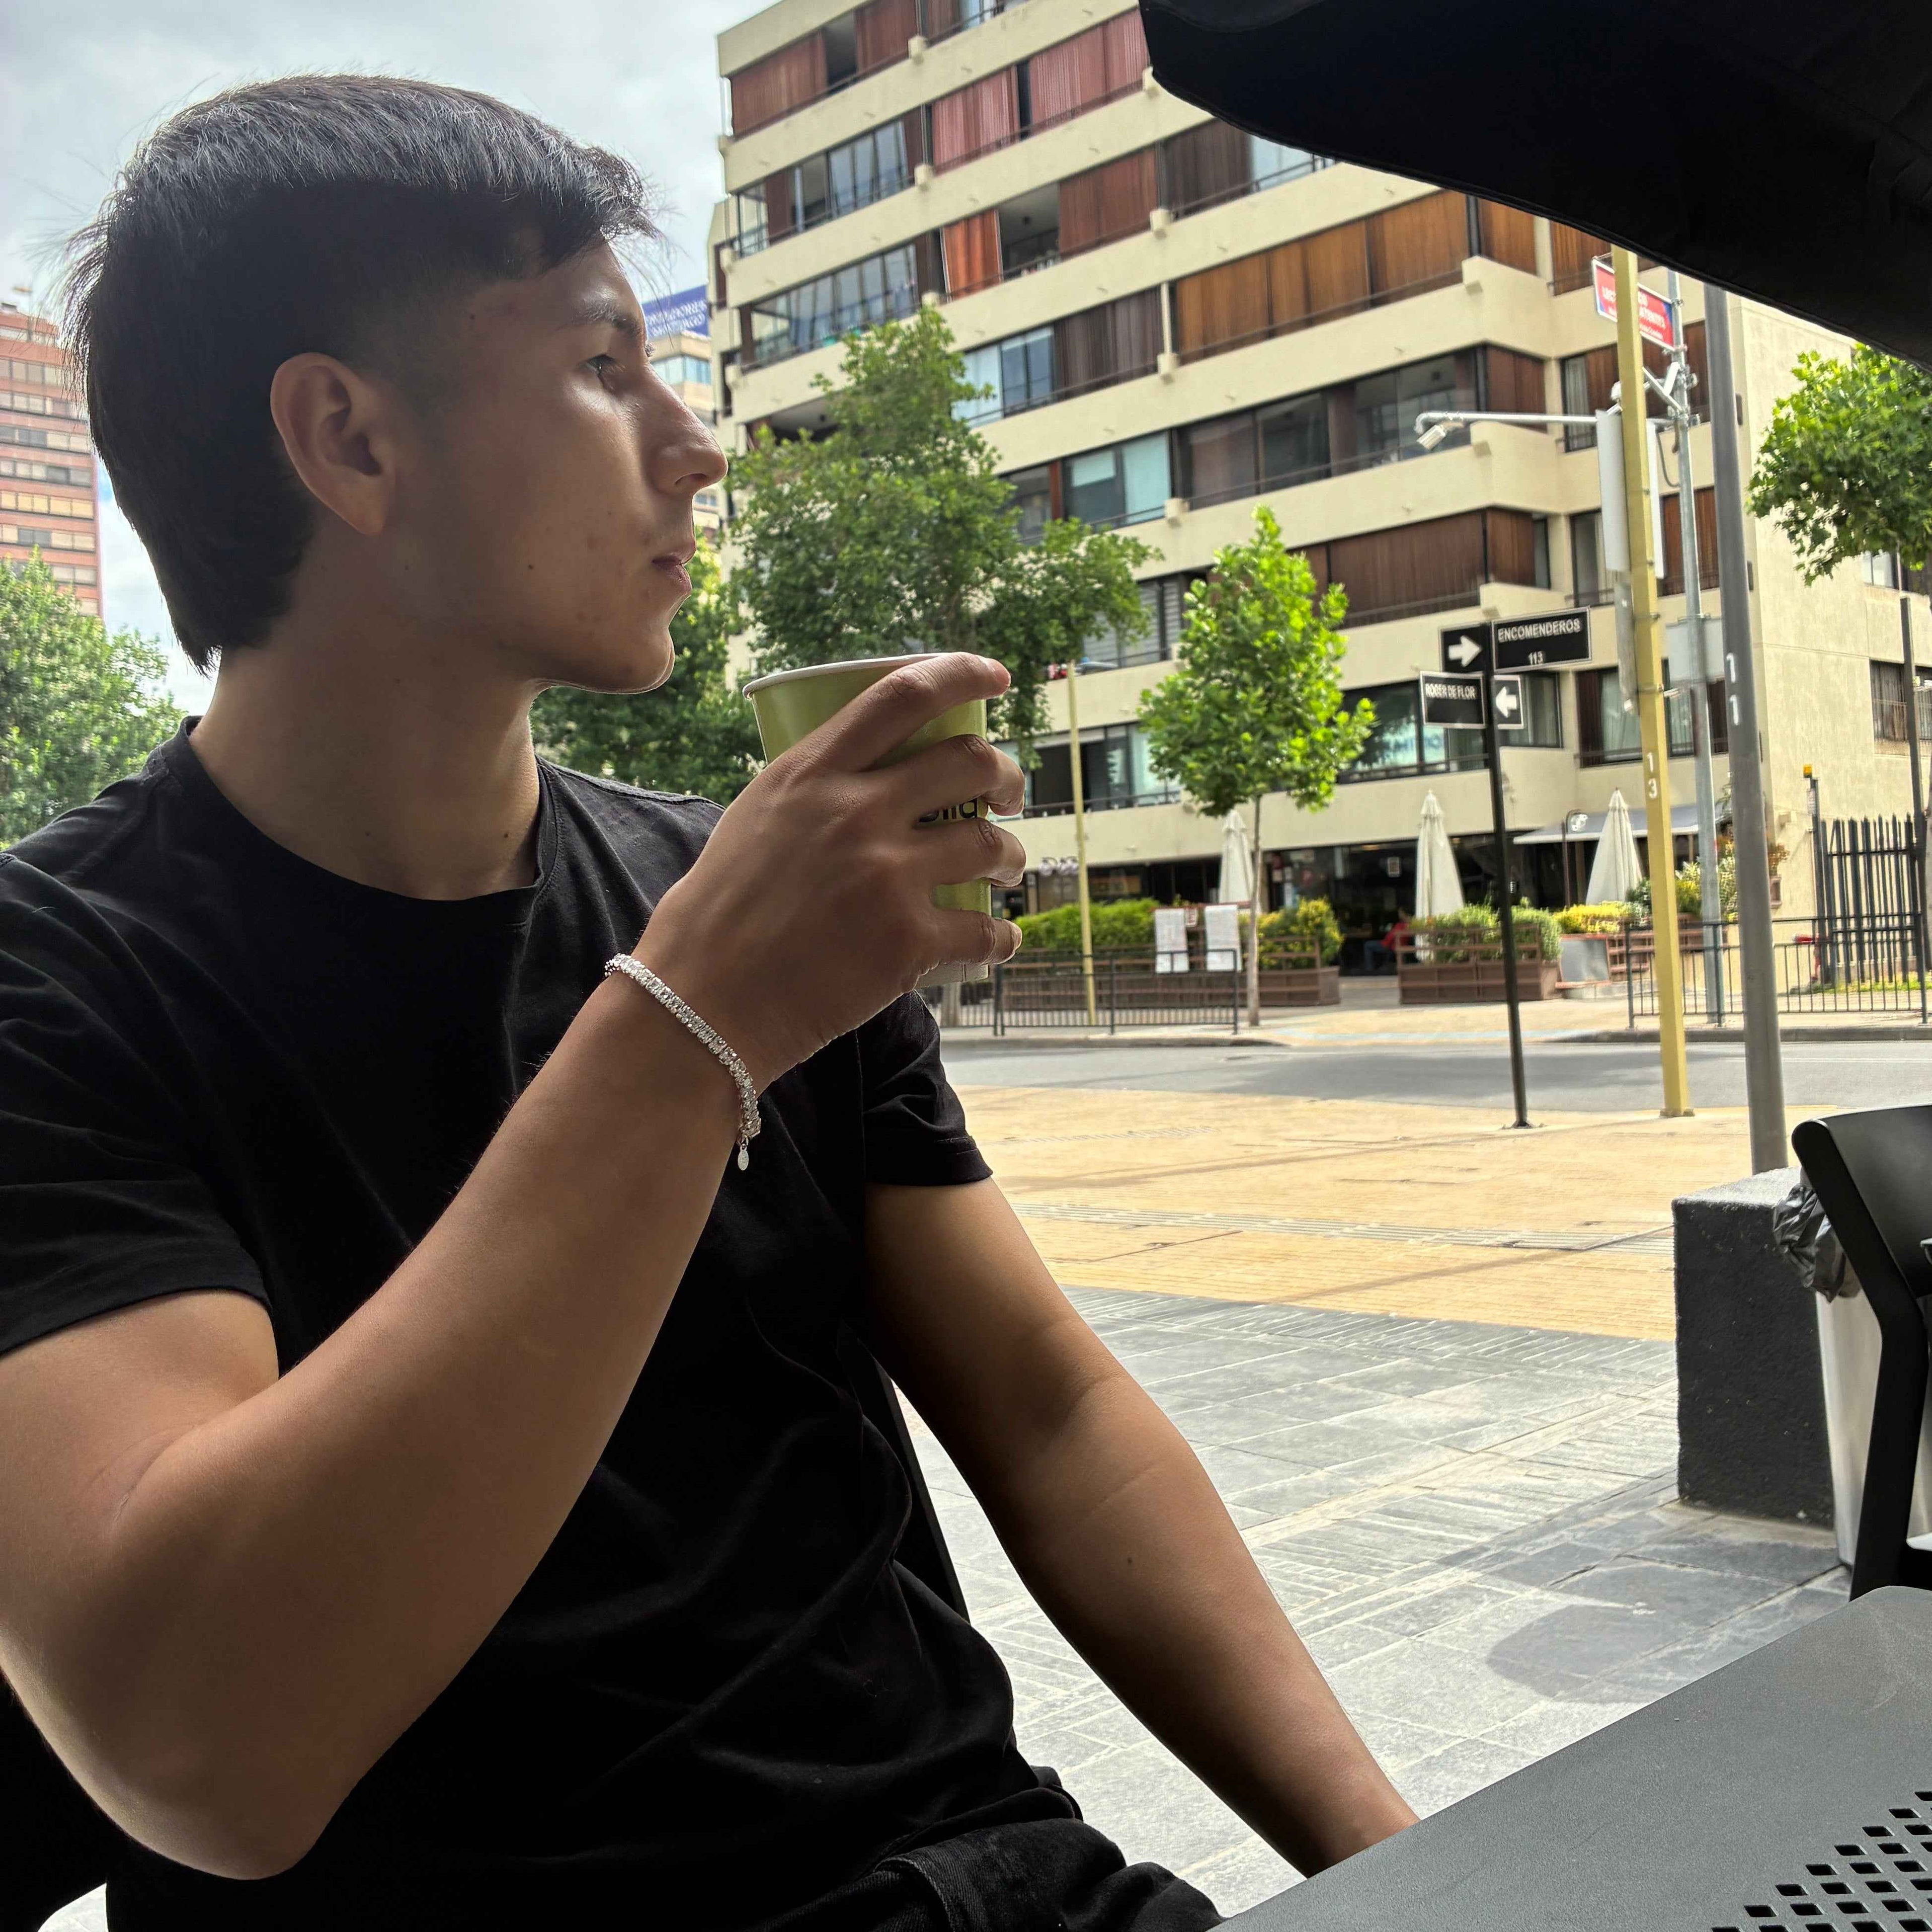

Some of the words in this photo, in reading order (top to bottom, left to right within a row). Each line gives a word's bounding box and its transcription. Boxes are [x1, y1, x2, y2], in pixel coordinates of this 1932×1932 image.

[1498, 618, 1581, 642] ENCOMENDEROS
[1425, 683, 1447, 698] ROGER
[1448, 685, 1457, 699] DE
[1457, 685, 1476, 700] FLOR
